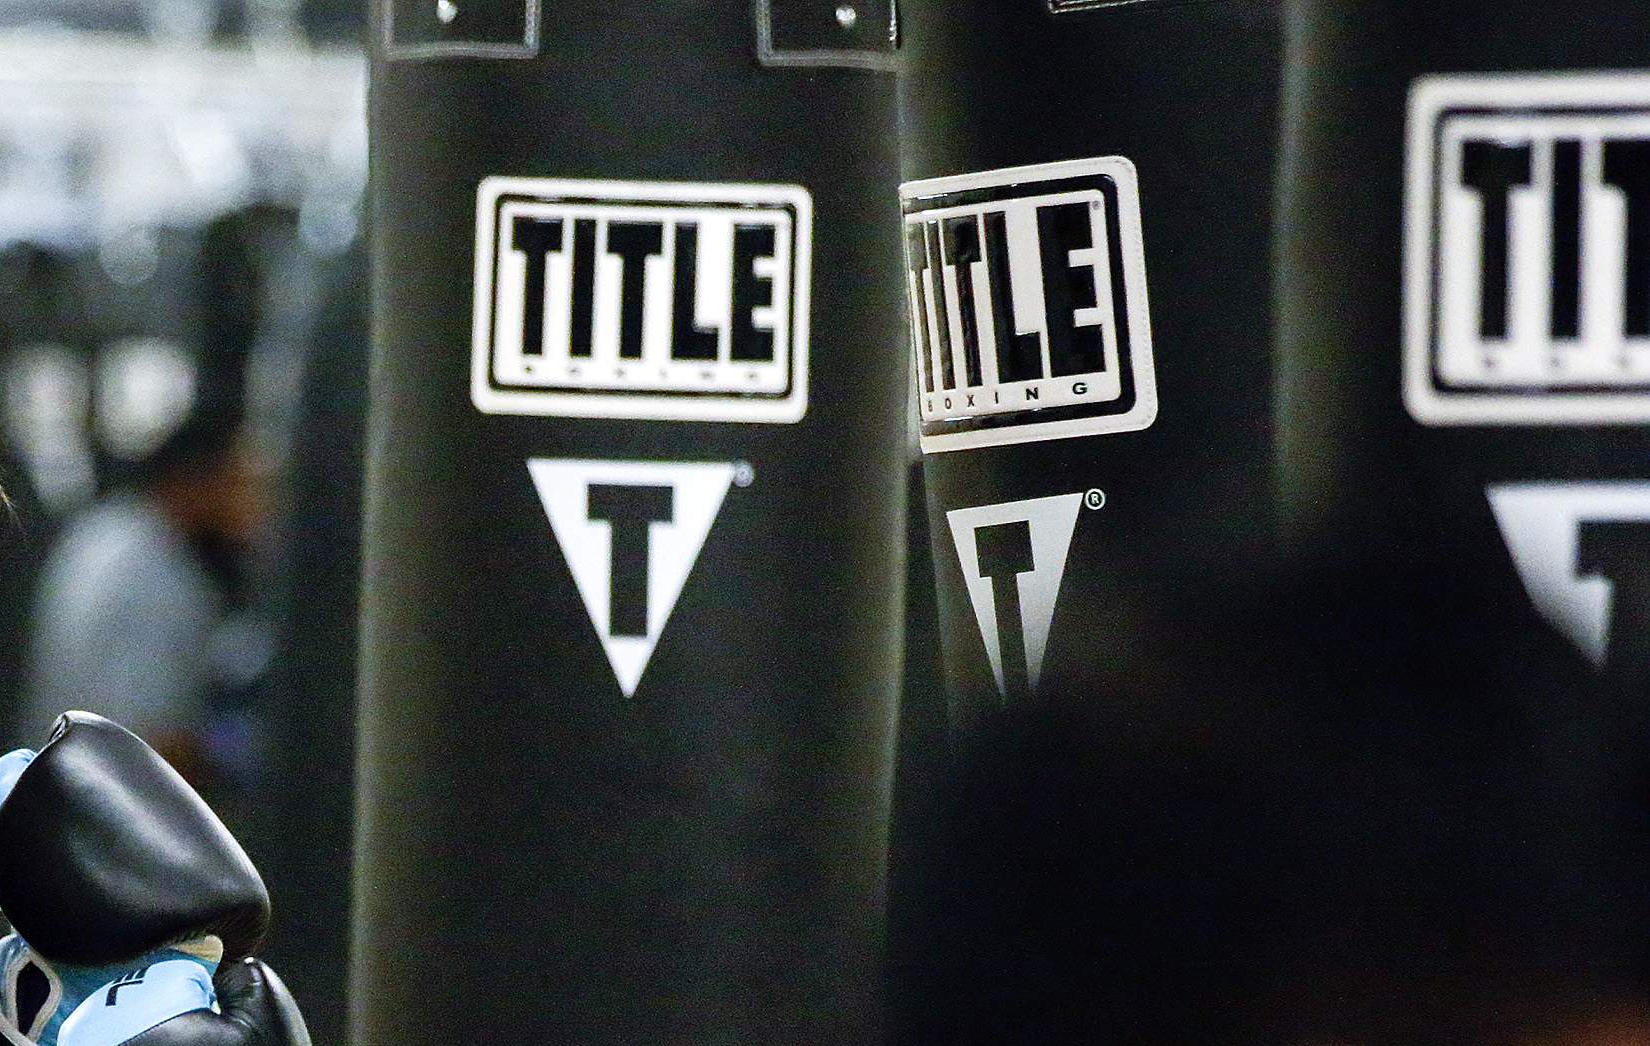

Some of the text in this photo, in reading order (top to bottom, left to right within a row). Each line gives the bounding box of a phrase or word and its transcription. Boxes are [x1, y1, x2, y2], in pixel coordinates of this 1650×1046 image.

[511, 218, 776, 361] TITLE
[907, 200, 1107, 393] TITLE
[926, 382, 1088, 413] BOXING
[587, 484, 674, 638] T
